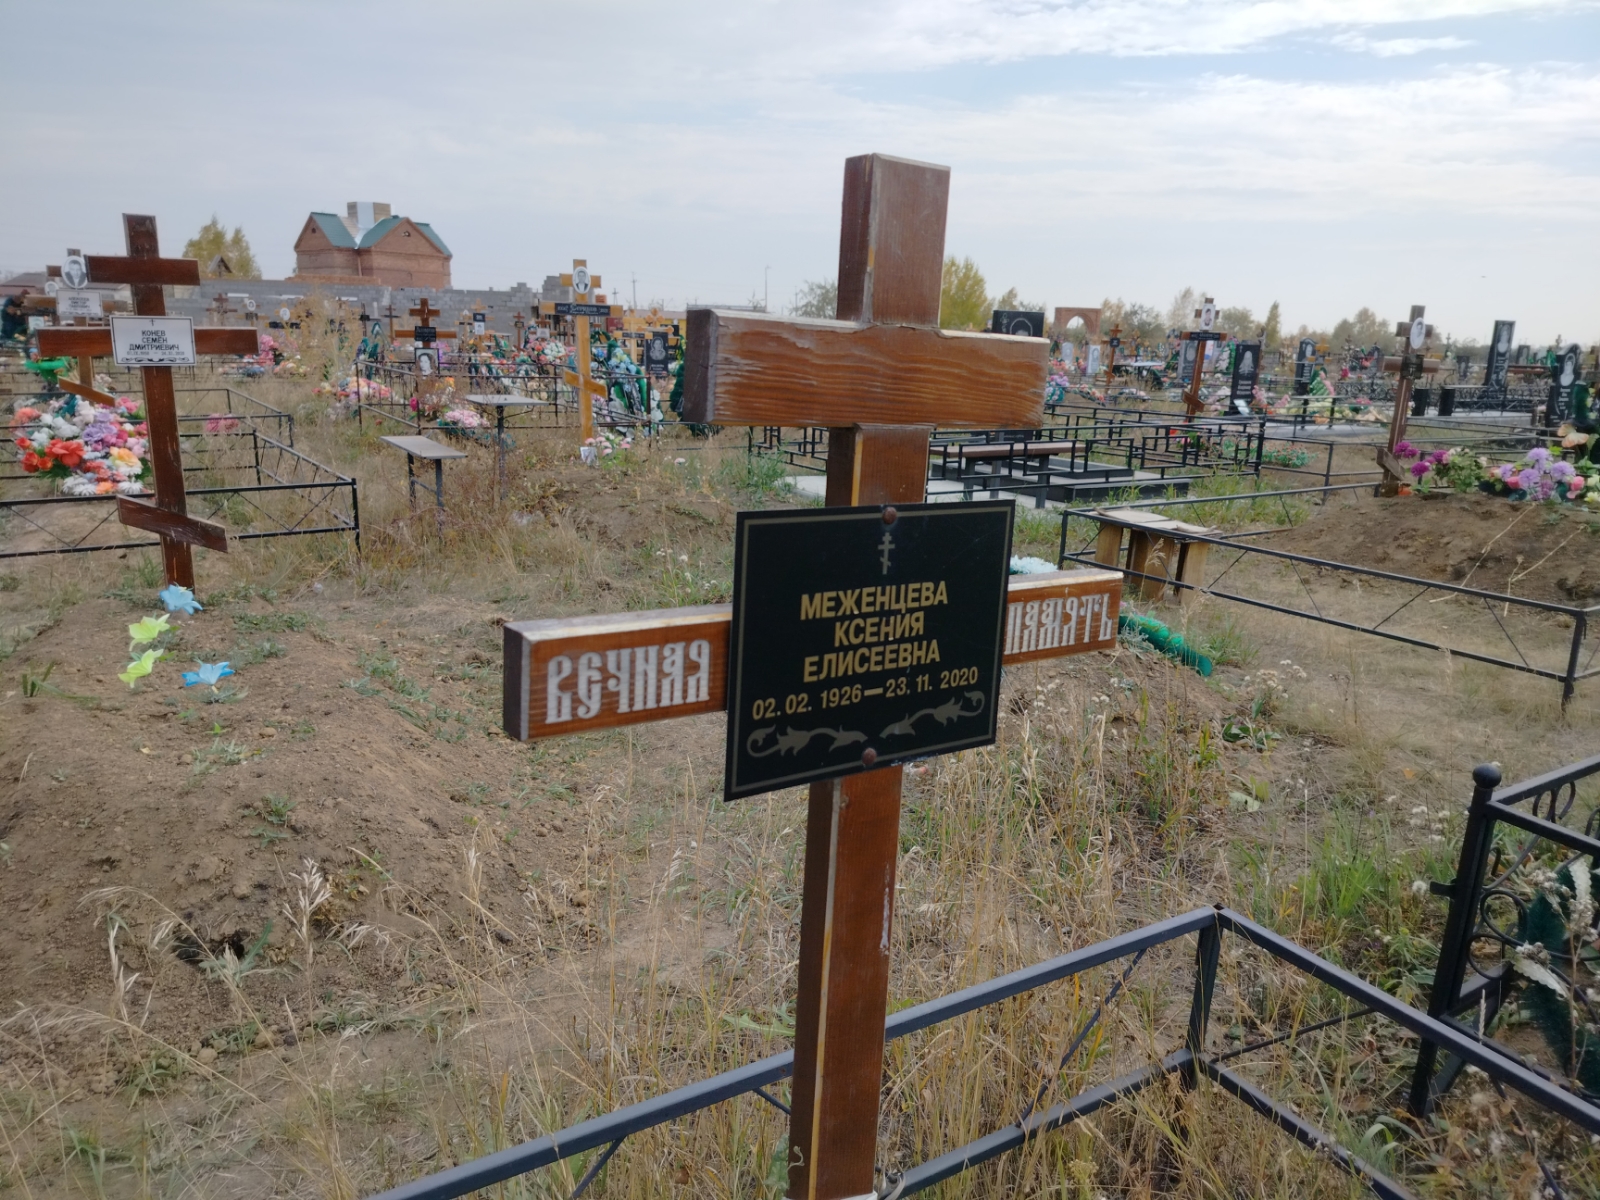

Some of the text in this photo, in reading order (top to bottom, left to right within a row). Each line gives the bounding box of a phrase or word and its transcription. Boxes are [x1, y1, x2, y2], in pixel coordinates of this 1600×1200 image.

[800, 581, 948, 620] МЕЖЕНЦЕВА
[834, 611, 925, 647] КСЕНИЯ
[545, 593, 1112, 724] ВЕЧНАЯ ПАМЯТЬ
[803, 639, 940, 683] ЕЛИСЕЕВНА
[940, 666, 979, 689] 2020
